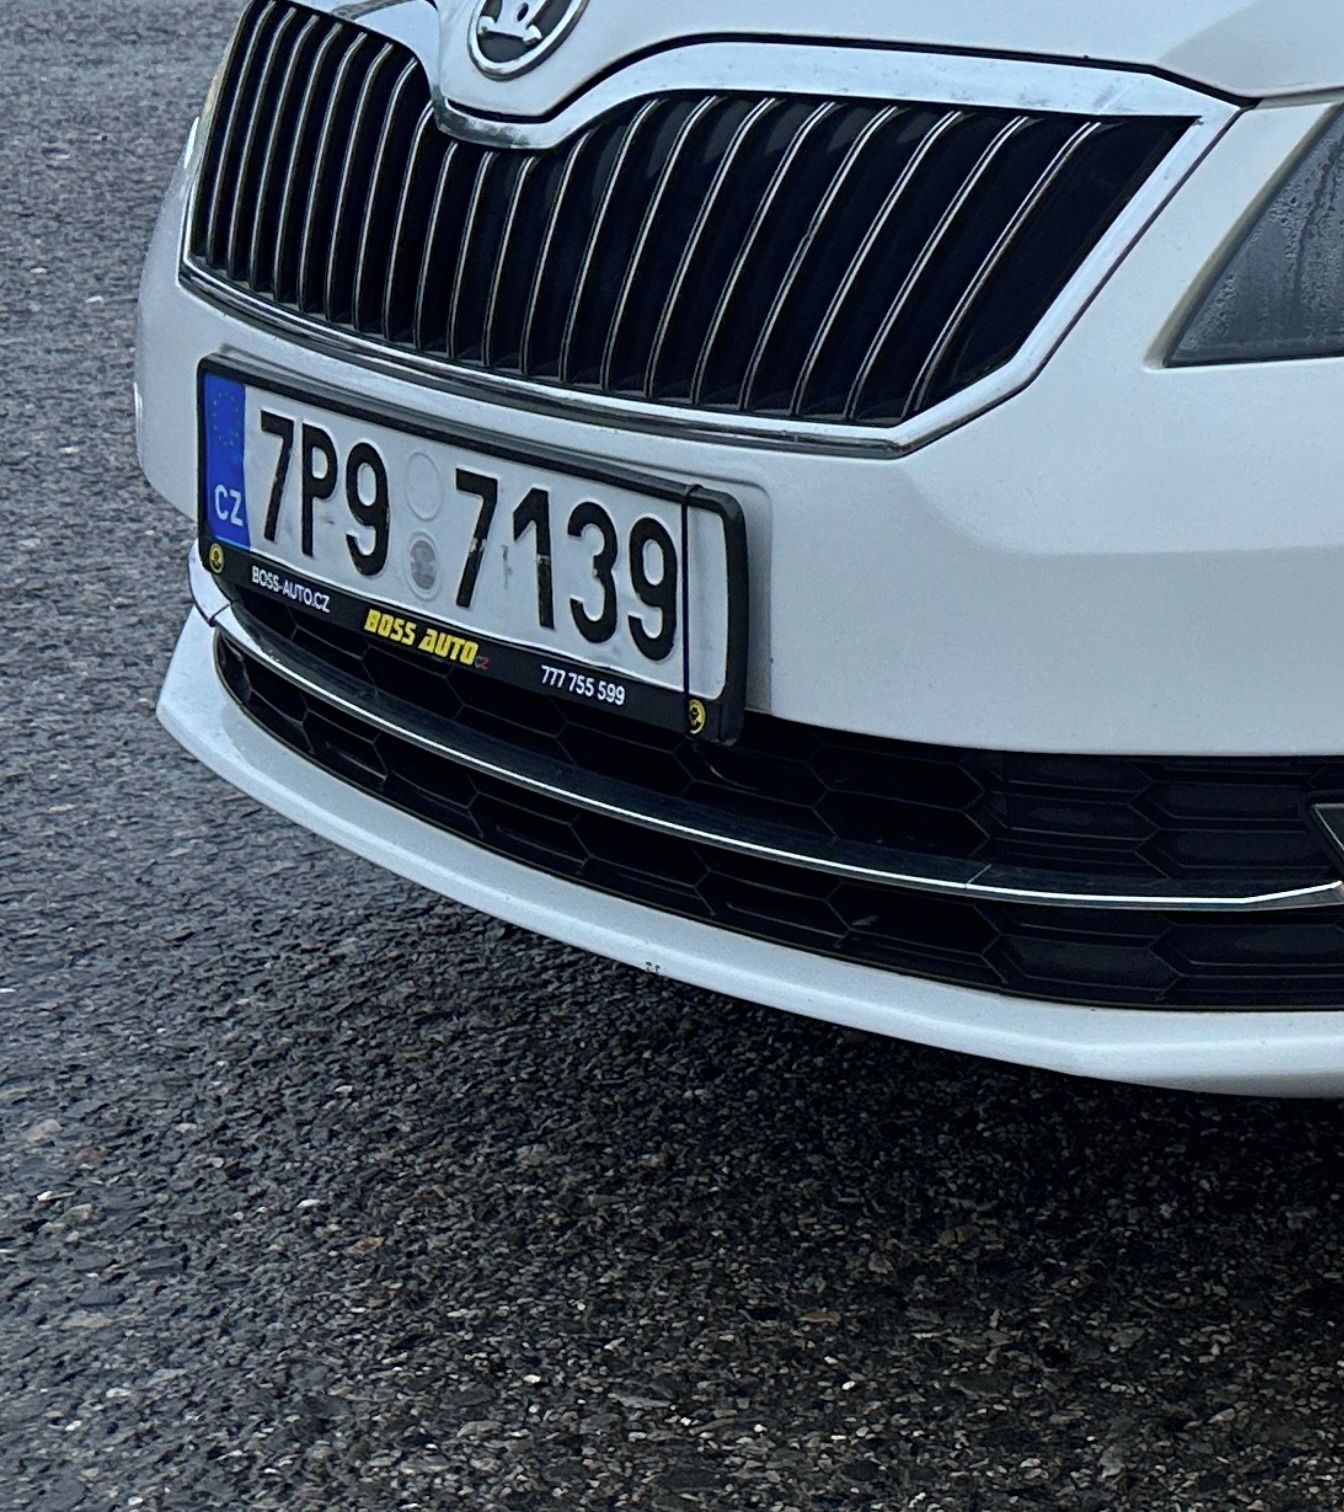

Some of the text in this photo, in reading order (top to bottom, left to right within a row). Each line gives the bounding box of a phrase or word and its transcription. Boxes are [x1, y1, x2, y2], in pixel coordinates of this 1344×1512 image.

[213, 483, 245, 528] CZ
[260, 409, 679, 662] 7P9 7139
[251, 564, 331, 614] BOSS-AUTO.CZ
[364, 607, 418, 646] BOSS
[540, 664, 627, 706] 777 755 599
